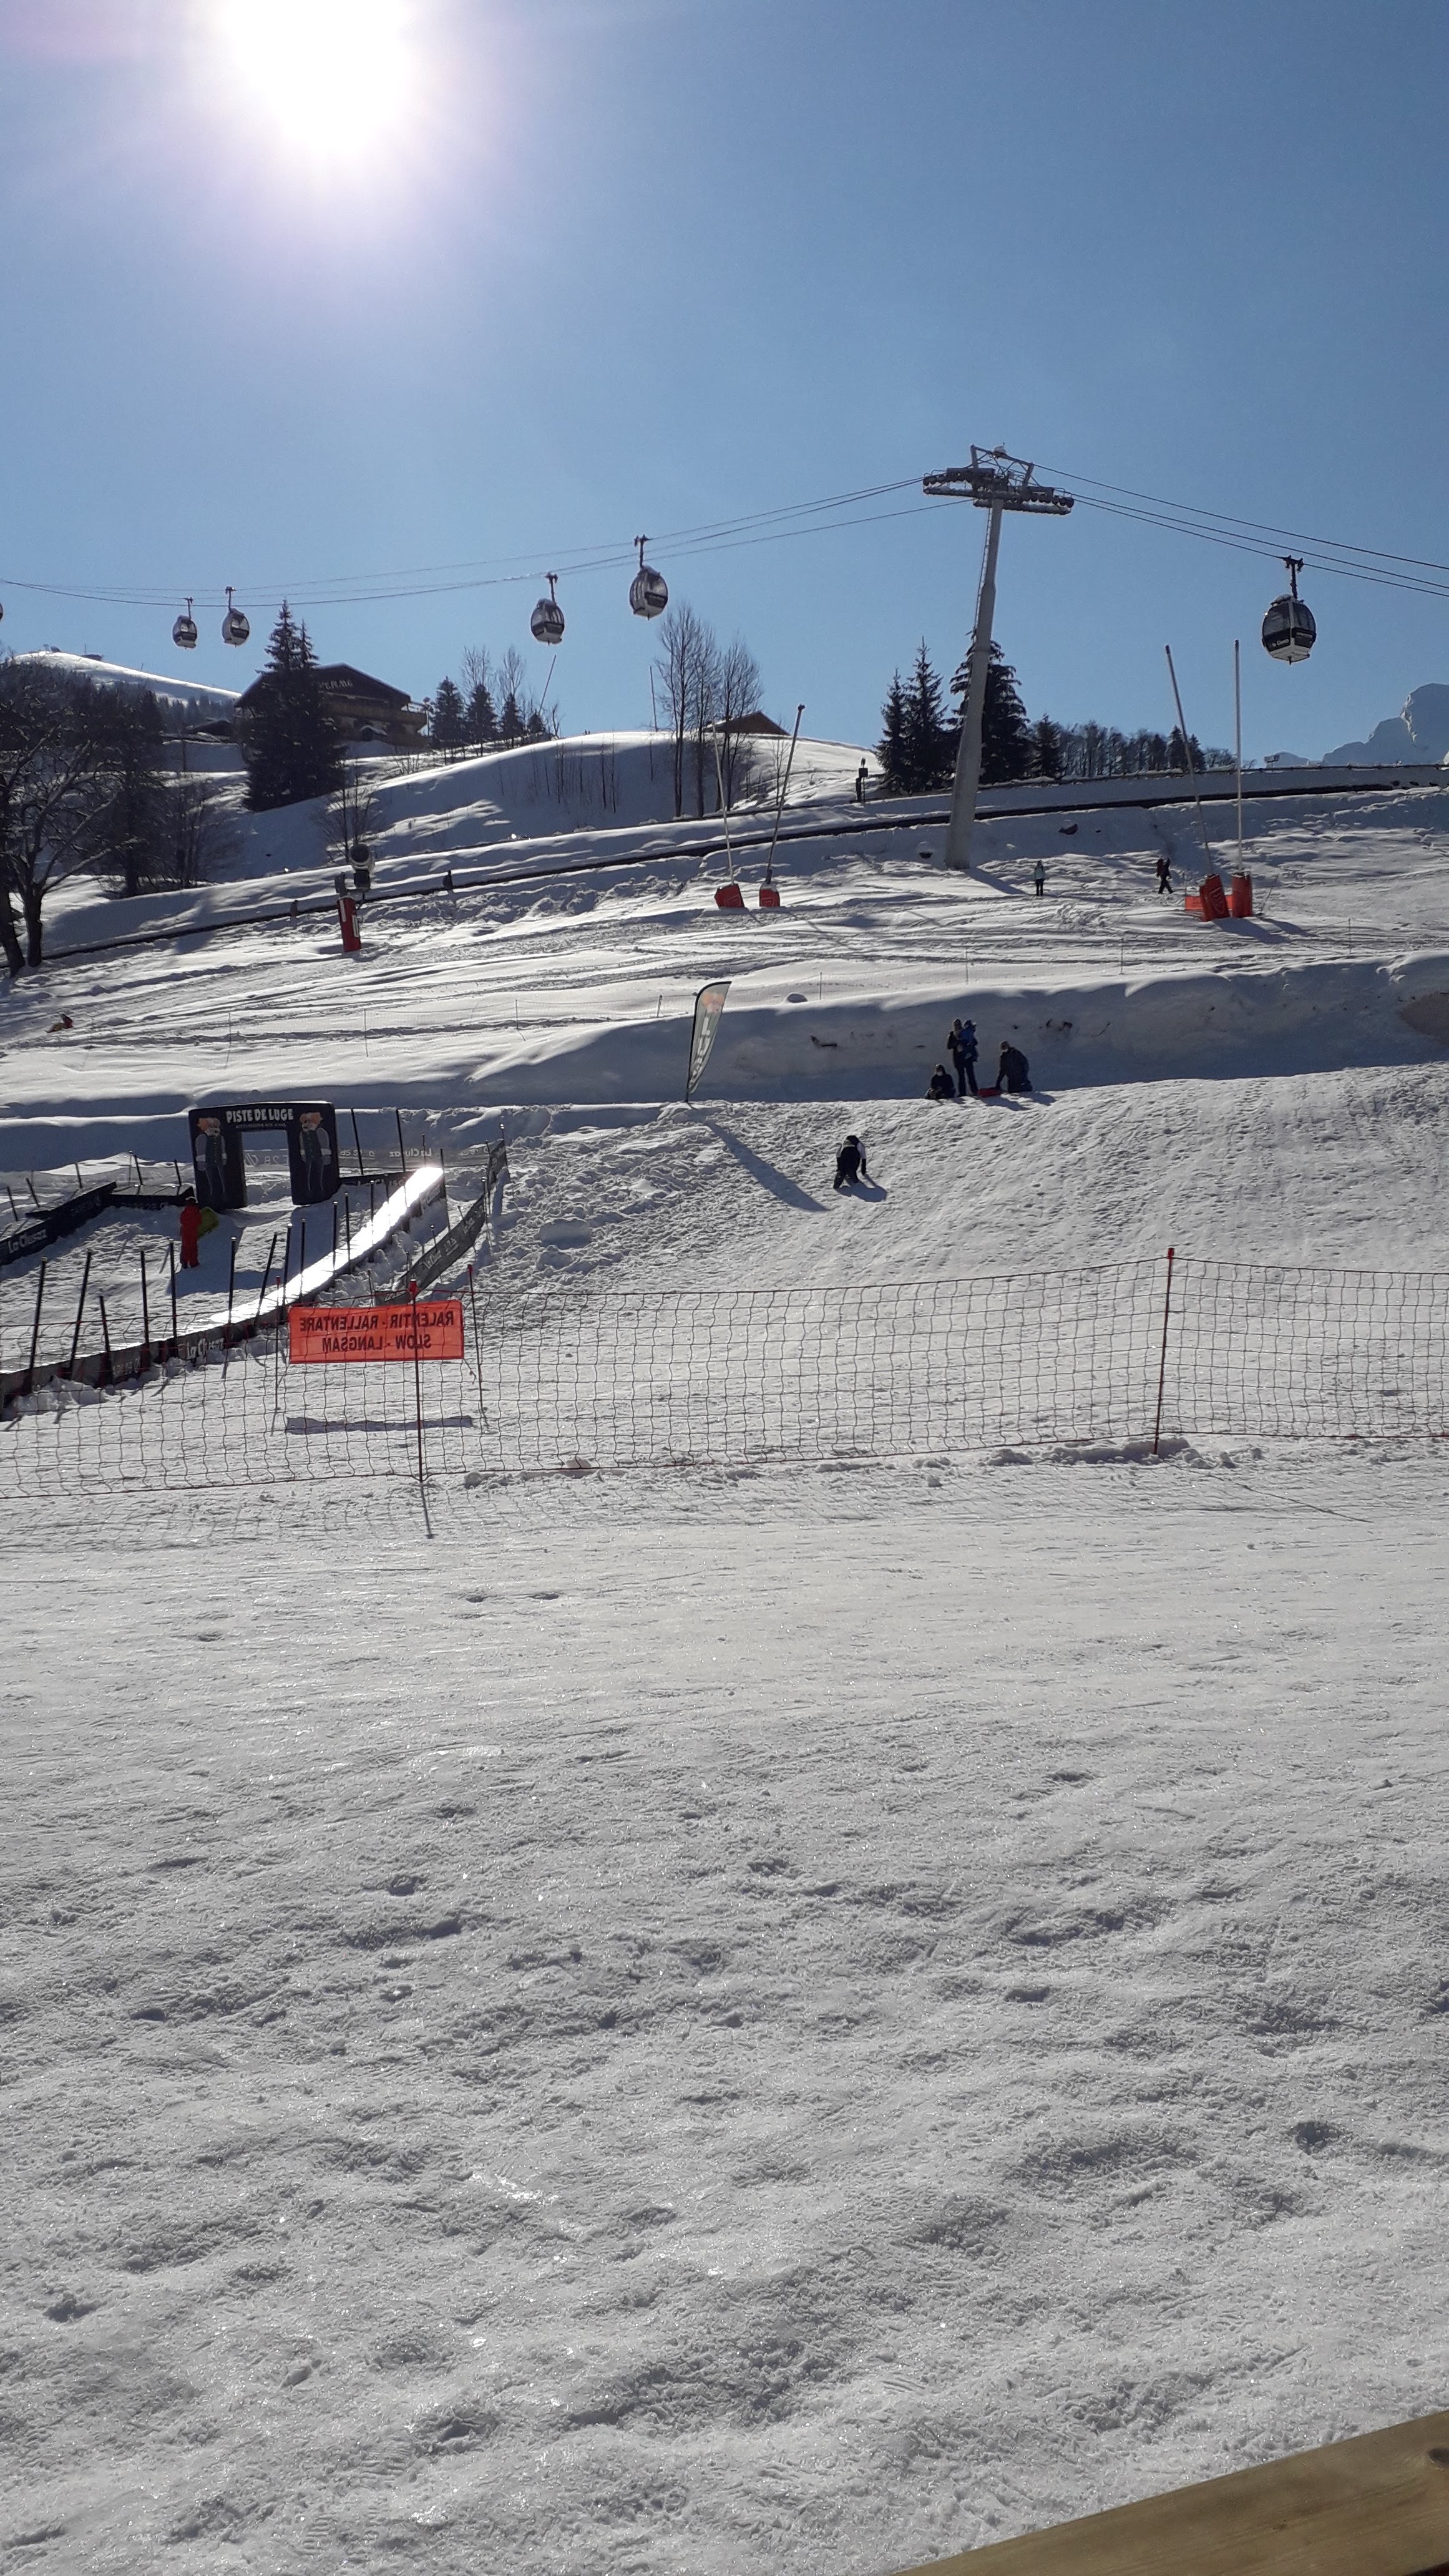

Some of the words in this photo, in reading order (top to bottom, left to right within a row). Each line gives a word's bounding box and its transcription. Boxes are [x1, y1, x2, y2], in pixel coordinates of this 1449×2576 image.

[225, 1110, 253, 1123] PISTE
[253, 1108, 267, 1121] DE
[268, 1108, 294, 1121] LUGE
